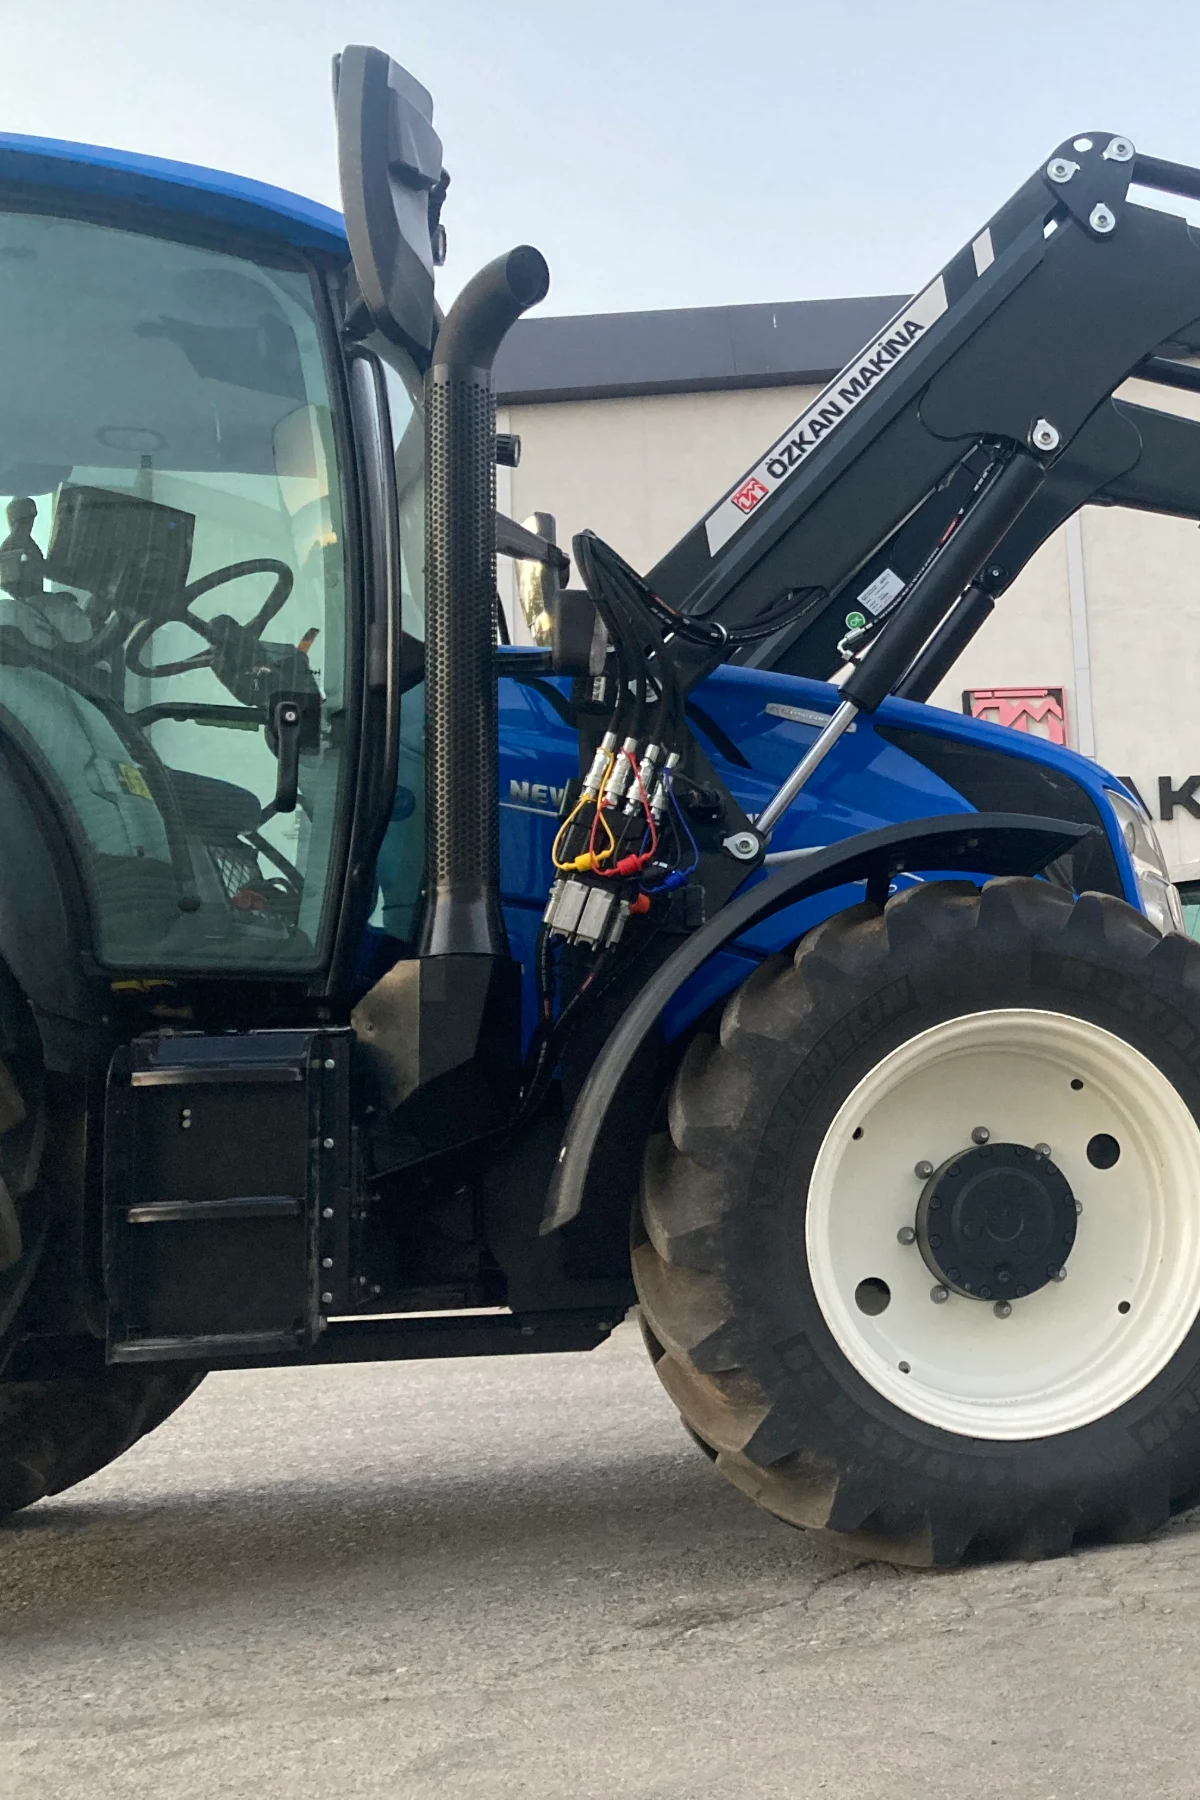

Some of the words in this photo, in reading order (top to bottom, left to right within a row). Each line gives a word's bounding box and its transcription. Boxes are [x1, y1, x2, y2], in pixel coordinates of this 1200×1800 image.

[765, 400, 843, 479] ÖZKAN
[838, 319, 924, 405] MAKİNA
[850, 616, 862, 627] OK
